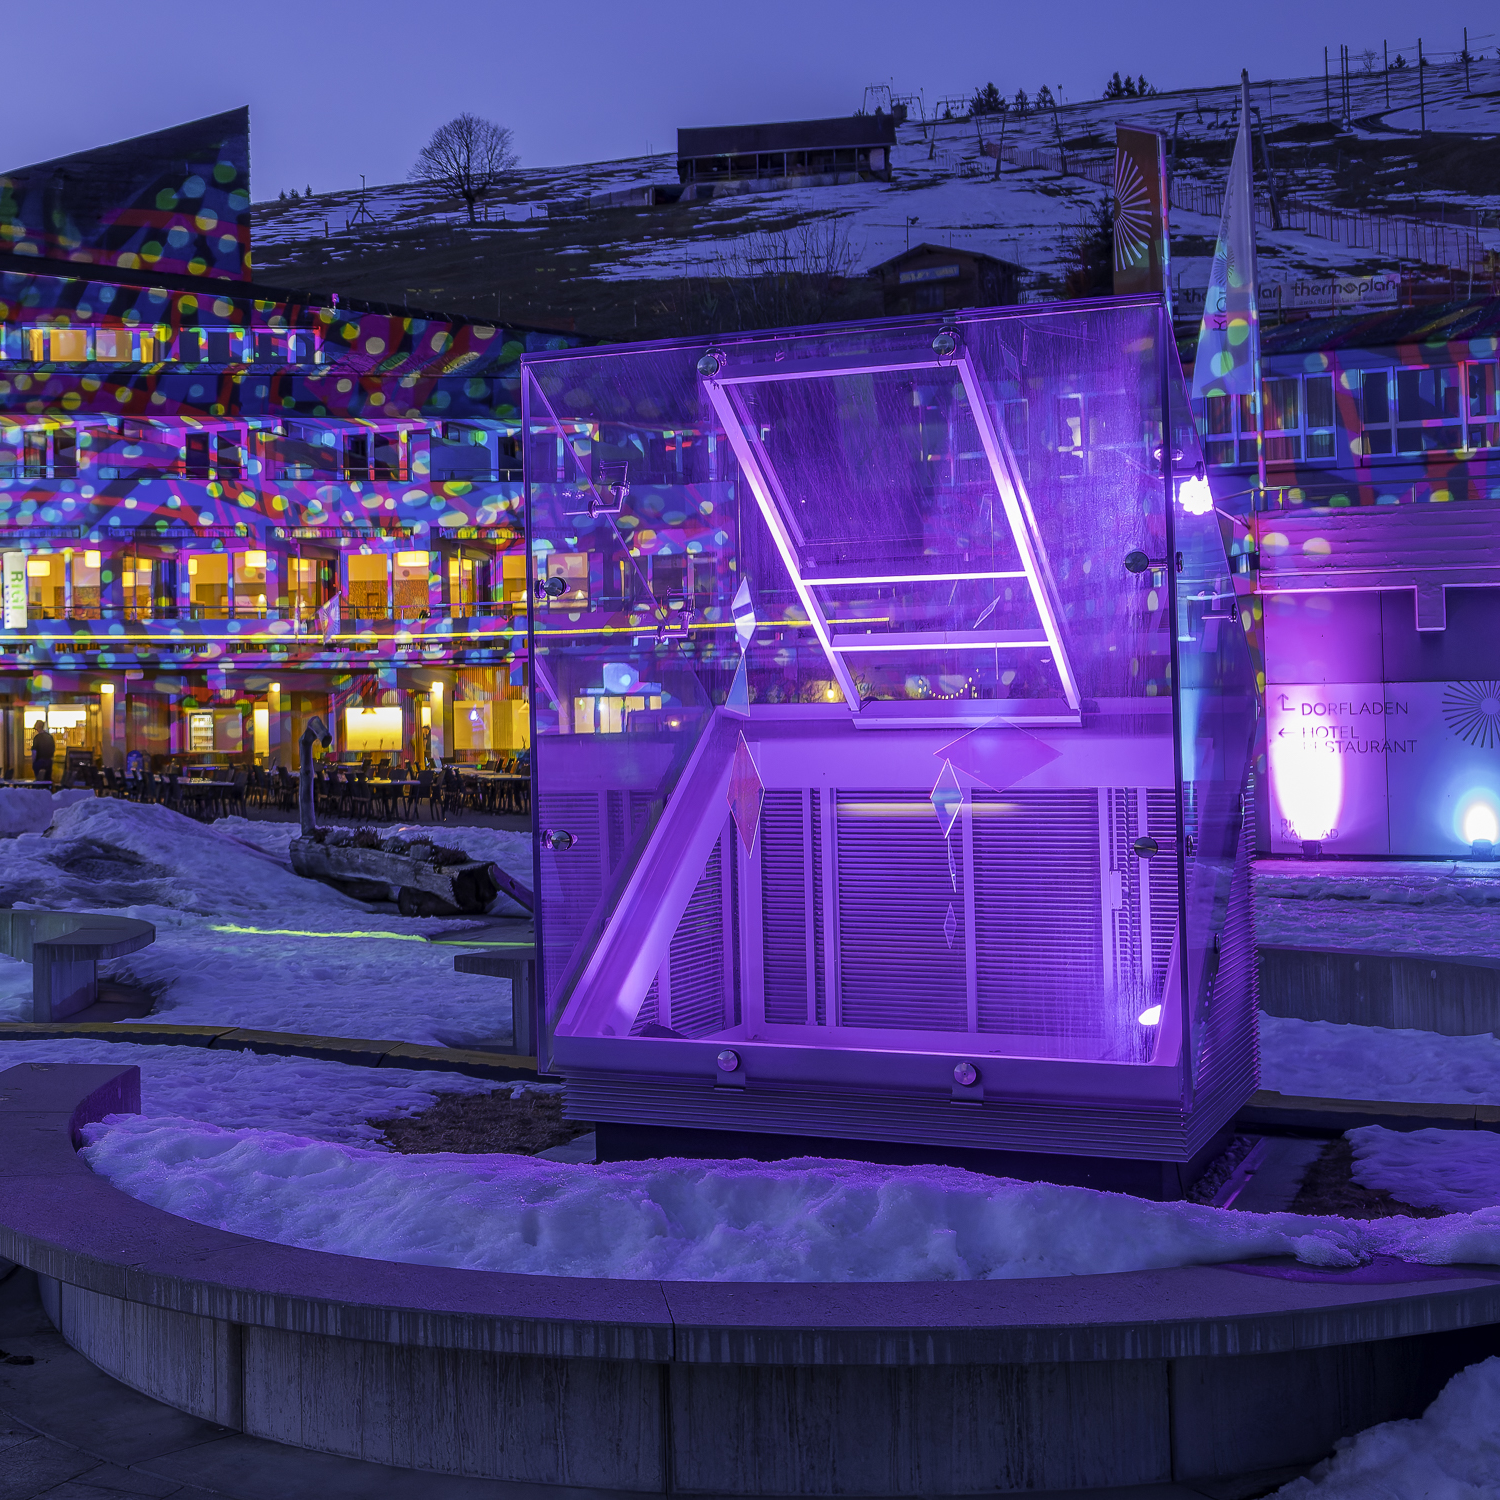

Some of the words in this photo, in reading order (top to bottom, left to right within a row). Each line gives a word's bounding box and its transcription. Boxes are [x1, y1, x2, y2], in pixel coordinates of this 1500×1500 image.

[1292, 278, 1396, 297] thermoplan
[11, 571, 24, 609] RIGI
[1301, 702, 1408, 716] DORFLADEN
[1302, 726, 1360, 739] HOTEL
[1303, 740, 1418, 753] STAURANT
